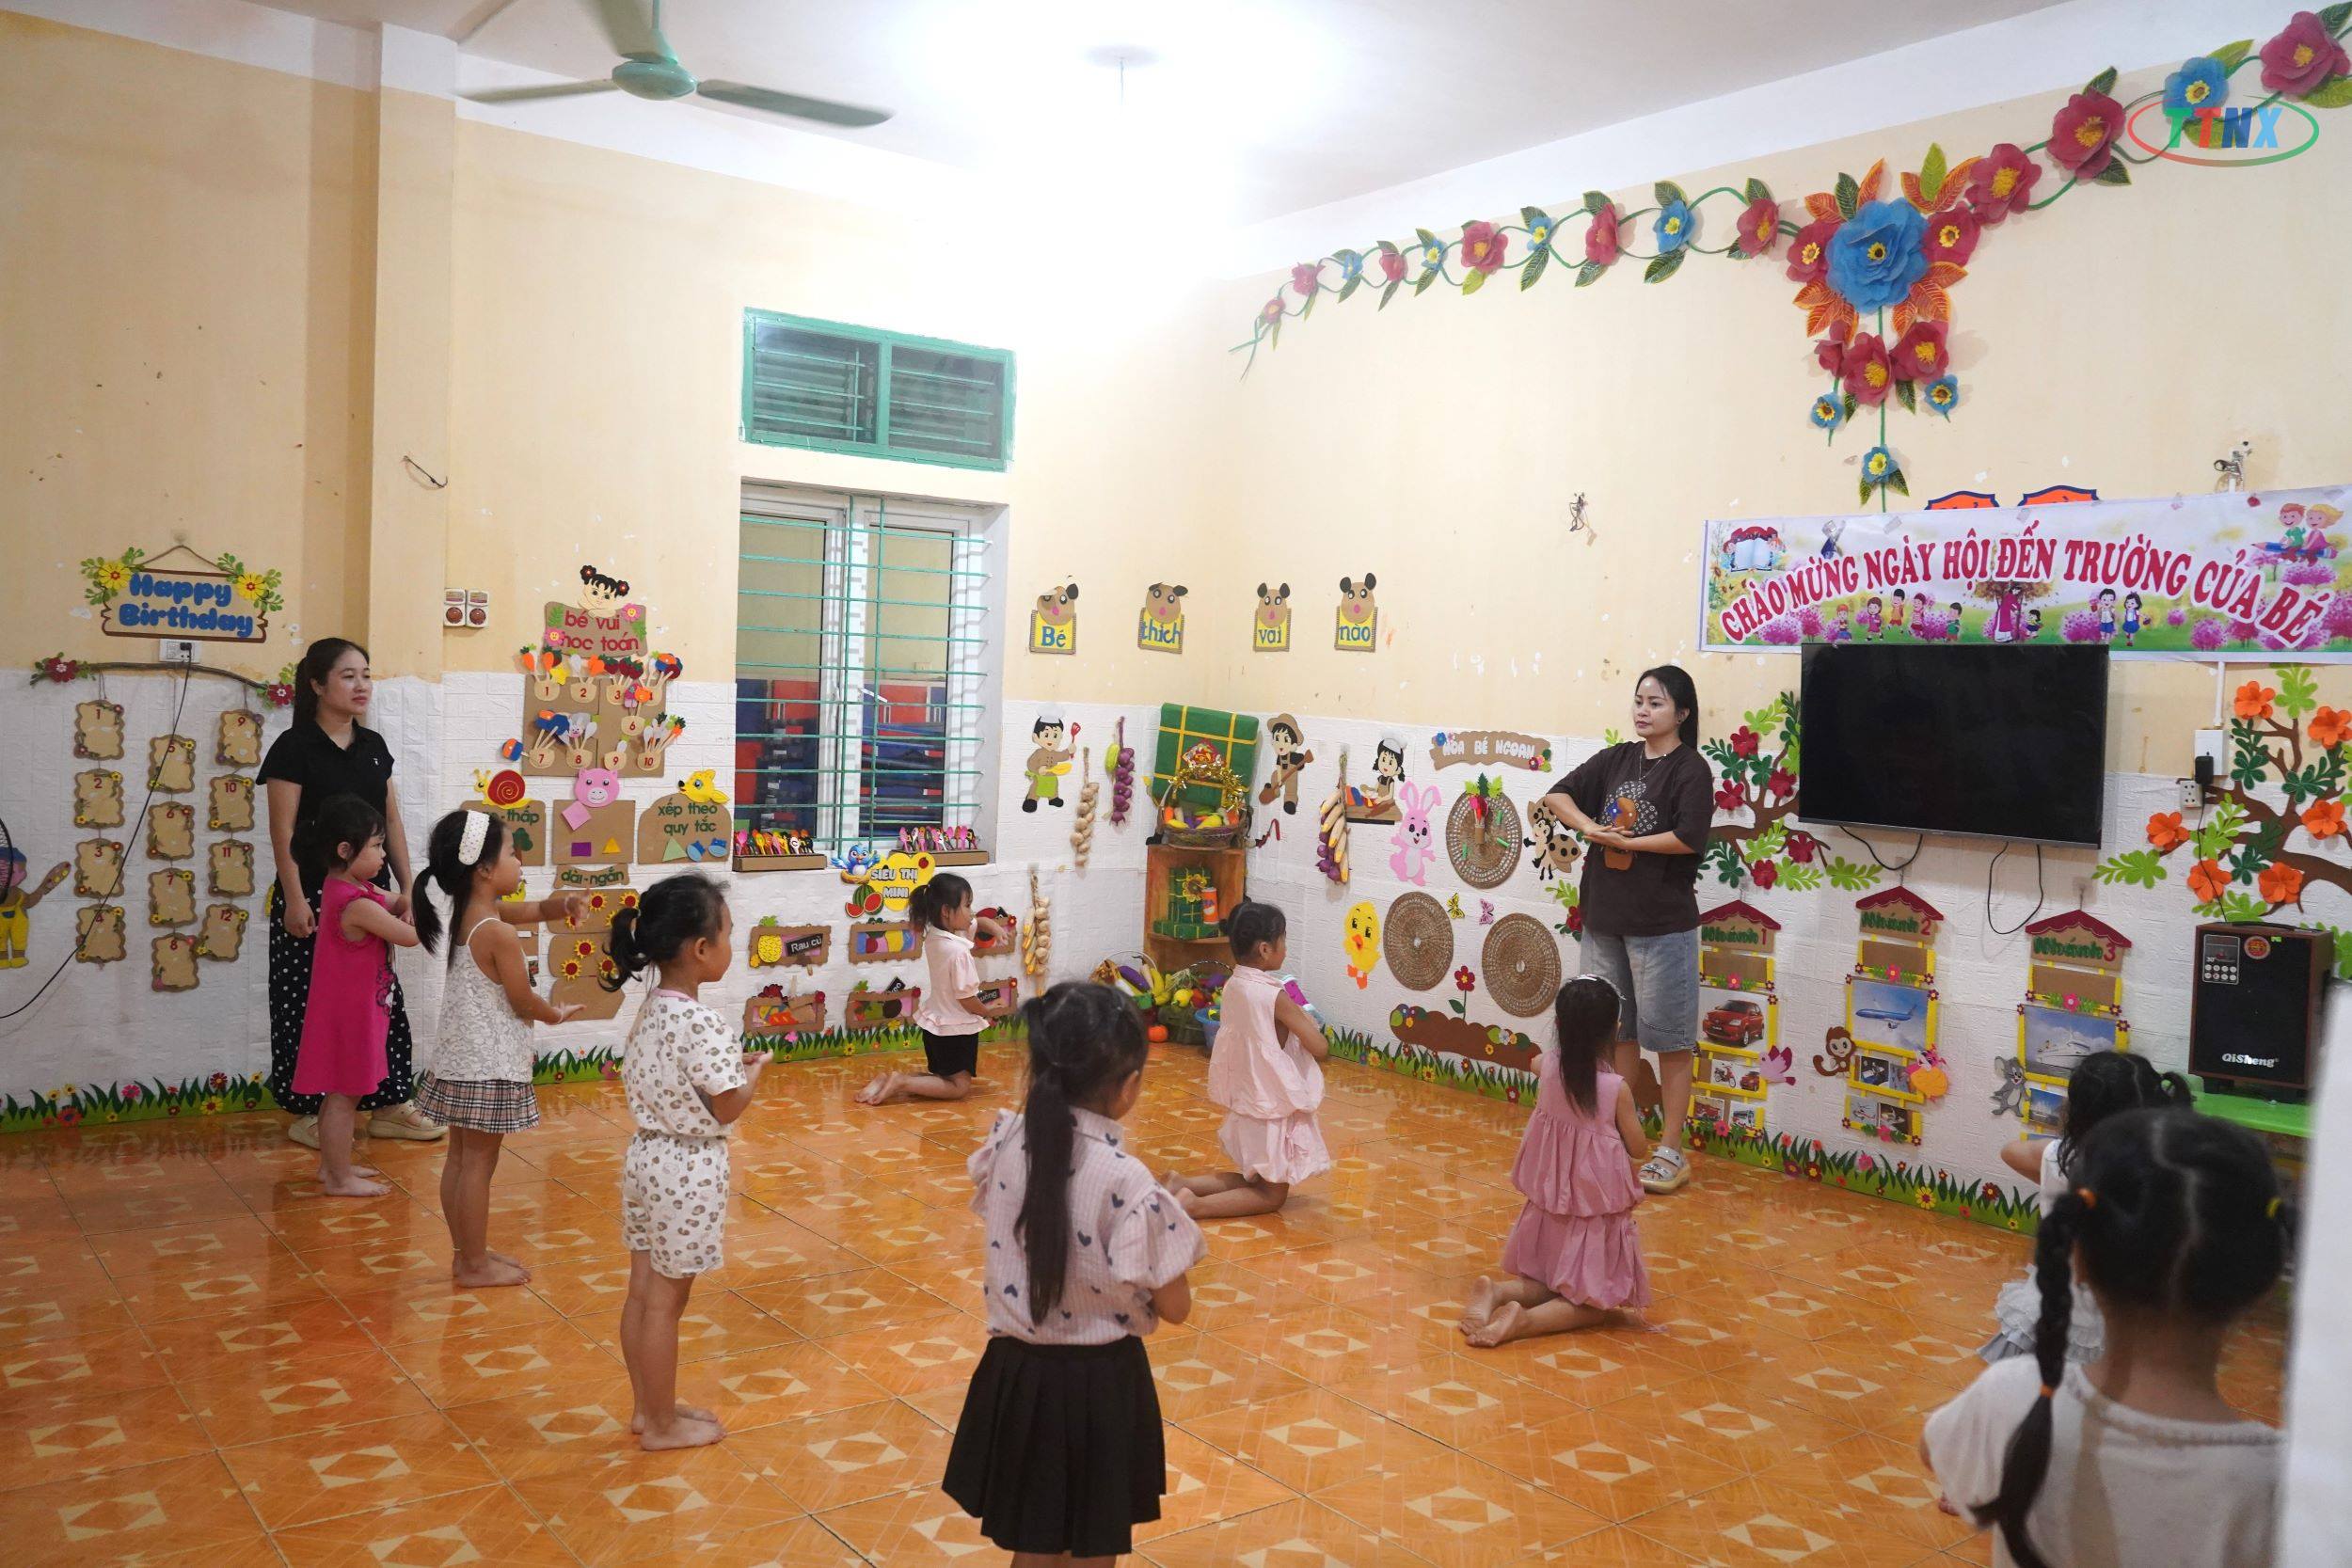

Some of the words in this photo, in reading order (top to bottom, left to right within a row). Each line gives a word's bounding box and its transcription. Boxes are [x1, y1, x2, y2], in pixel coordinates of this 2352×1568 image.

[1722, 580, 1786, 641] CHÀO
[1787, 556, 1859, 610] MỪNG
[1864, 535, 1936, 590] NGÀY
[1942, 528, 1991, 591] HỘI
[1995, 519, 2058, 579] ĐẾN
[2063, 533, 2192, 597] TRƯỜNG
[2194, 548, 2262, 621] CỦA
[2259, 586, 2331, 643] BÉ
[130, 572, 231, 607] Happy
[119, 602, 253, 638] Birthday
[564, 610, 588, 628] bé
[596, 615, 620, 630] vui
[600, 632, 639, 651] toán
[1041, 626, 1067, 648] Bé
[1258, 626, 1282, 644] vai
[1339, 624, 1371, 642] nào
[545, 687, 548, 696] 1
[580, 689, 587, 698] 2
[614, 690, 621, 700] 3
[96, 708, 101, 721] 1
[237, 716, 246, 727] 9
[629, 721, 636, 731] 6
[1474, 736, 1488, 755] BÉ
[538, 754, 545, 764] 7
[575, 755, 581, 764] 8
[612, 756, 619, 766] 9
[644, 757, 654, 767] 10
[94, 778, 103, 789] 2
[225, 782, 237, 793] 10
[167, 808, 174, 818] 6
[658, 798, 683, 817] xếp
[688, 802, 718, 815] theo
[663, 823, 689, 836] quy
[694, 816, 717, 832] tắc
[94, 847, 103, 857] 3
[223, 847, 231, 857] 11
[167, 875, 174, 885] 7
[883, 887, 909, 898] MINI
[95, 911, 104, 924] 4
[220, 910, 232, 922] 12
[1920, 919, 1931, 936] 2
[1761, 928, 1768, 945] 1
[170, 940, 178, 950] 8
[791, 942, 809, 953] Rau
[2104, 942, 2116, 961] 3
[2222, 1053, 2275, 1068] QiSheng
